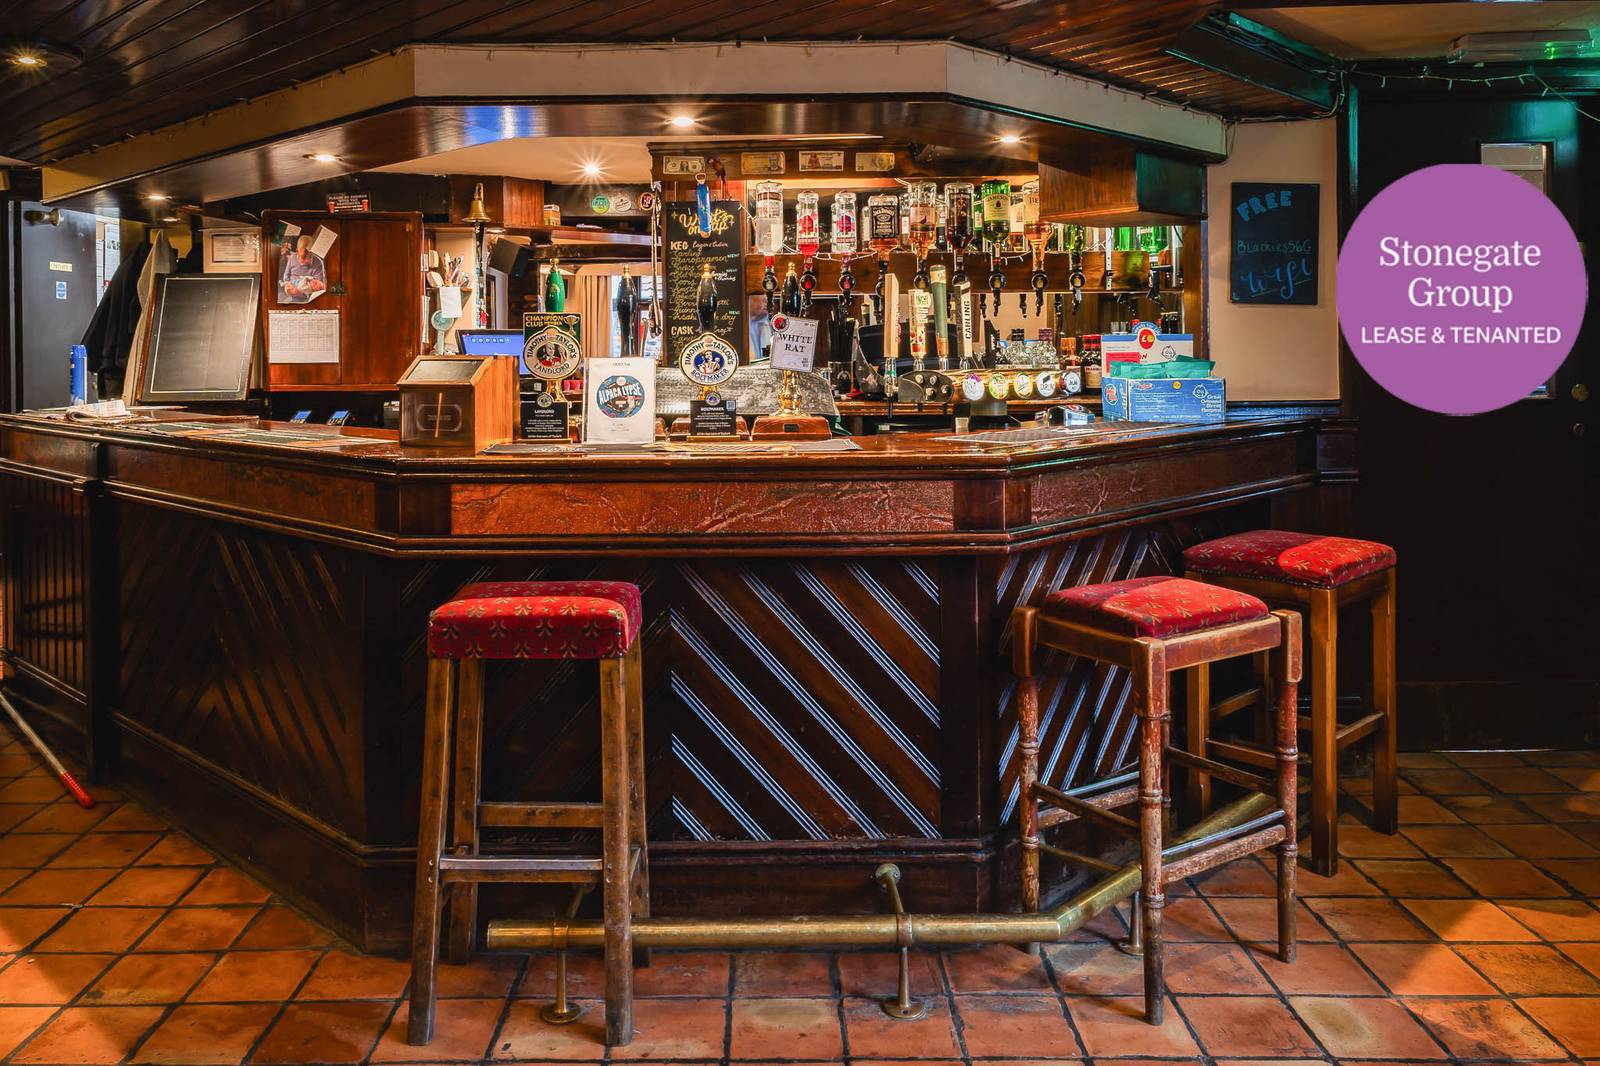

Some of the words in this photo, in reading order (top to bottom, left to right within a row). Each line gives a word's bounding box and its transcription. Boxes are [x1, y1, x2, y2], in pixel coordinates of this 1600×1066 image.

[1236, 190, 1292, 222] FREE
[670, 241, 688, 250] KEG
[671, 326, 694, 336] CASK
[780, 334, 813, 344] WHITE
[527, 335, 547, 357] TIMOTHY
[556, 335, 577, 358] TAYLOR'S
[785, 344, 806, 352] RAT
[685, 342, 705, 365] TIMOTHY
[712, 342, 733, 365] TAYLOR'S
[534, 363, 570, 375] LANDLORD
[690, 368, 729, 381] BOLTMAKER
